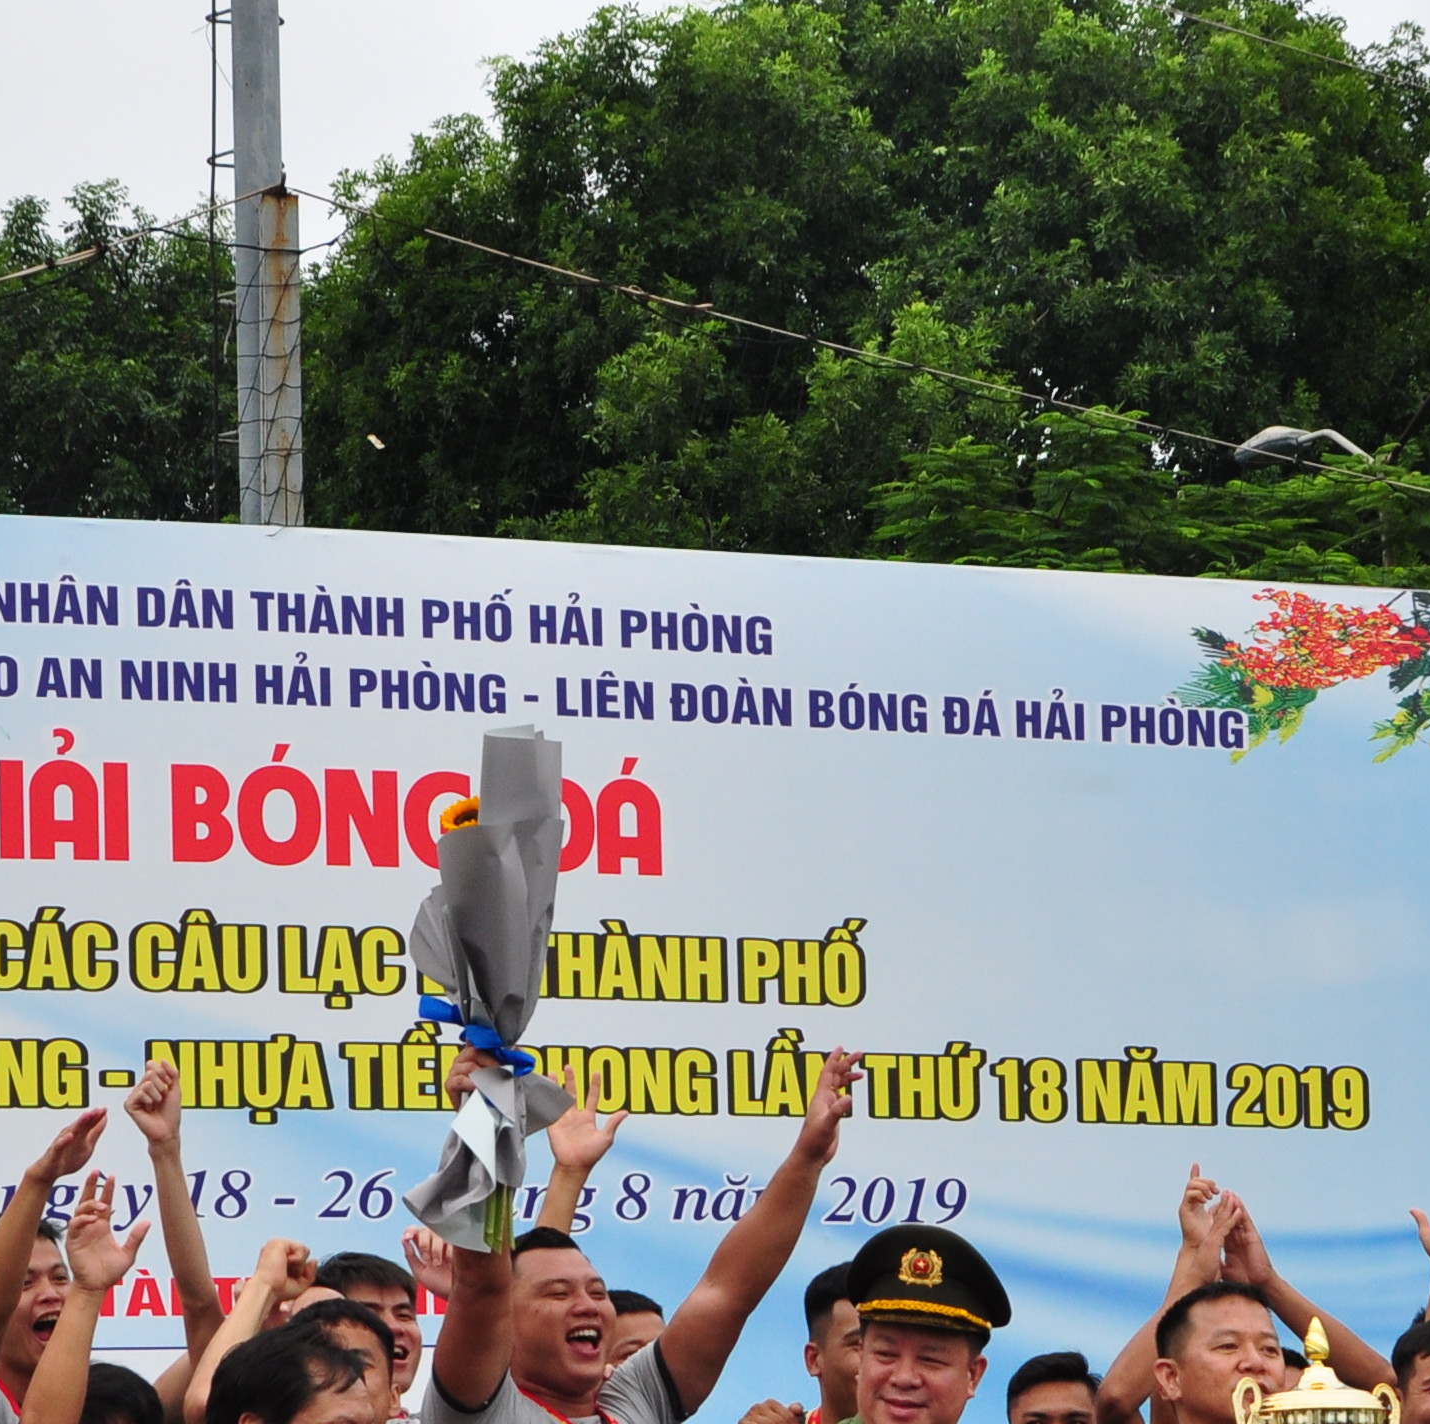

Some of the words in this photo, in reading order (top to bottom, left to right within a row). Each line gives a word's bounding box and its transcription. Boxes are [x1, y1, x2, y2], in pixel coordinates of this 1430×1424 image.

[136, 575, 234, 630] DÂN
[249, 582, 405, 638] THÀNH
[421, 586, 513, 643] PHỐ
[529, 590, 604, 647] HẢI
[620, 600, 773, 656] PHÒNG
[36, 656, 103, 700] AN
[120, 659, 238, 704] NINH
[254, 650, 332, 707] HẢI
[349, 660, 507, 715] PHÒNG
[523, 694, 540, 703] -
[555, 669, 655, 721] LIÊN
[669, 677, 793, 727] ĐOÀN
[808, 682, 928, 734] BÓNG
[941, 687, 1001, 737] ĐÁ
[1015, 685, 1086, 742] HẢI
[1100, 696, 1245, 749] PHÒNG
[130, 907, 267, 995] CÂU
[279, 923, 405, 1011] LẠC
[738, 916, 866, 1009] PHỐ
[100, 1069, 135, 1088] -
[146, 1034, 333, 1124] NHỰA
[860, 1040, 987, 1122] THỨ
[990, 1056, 1067, 1125] 18
[1076, 1044, 1217, 1127] NĂM
[1226, 1061, 1369, 1132] 2019
[186, 1168, 252, 1219] 18
[274, 1197, 296, 1206] -
[318, 1169, 395, 1219] 26
[616, 1172, 652, 1221] 8
[672, 1174, 768, 1222] nă
[823, 1175, 969, 1225] 2019
